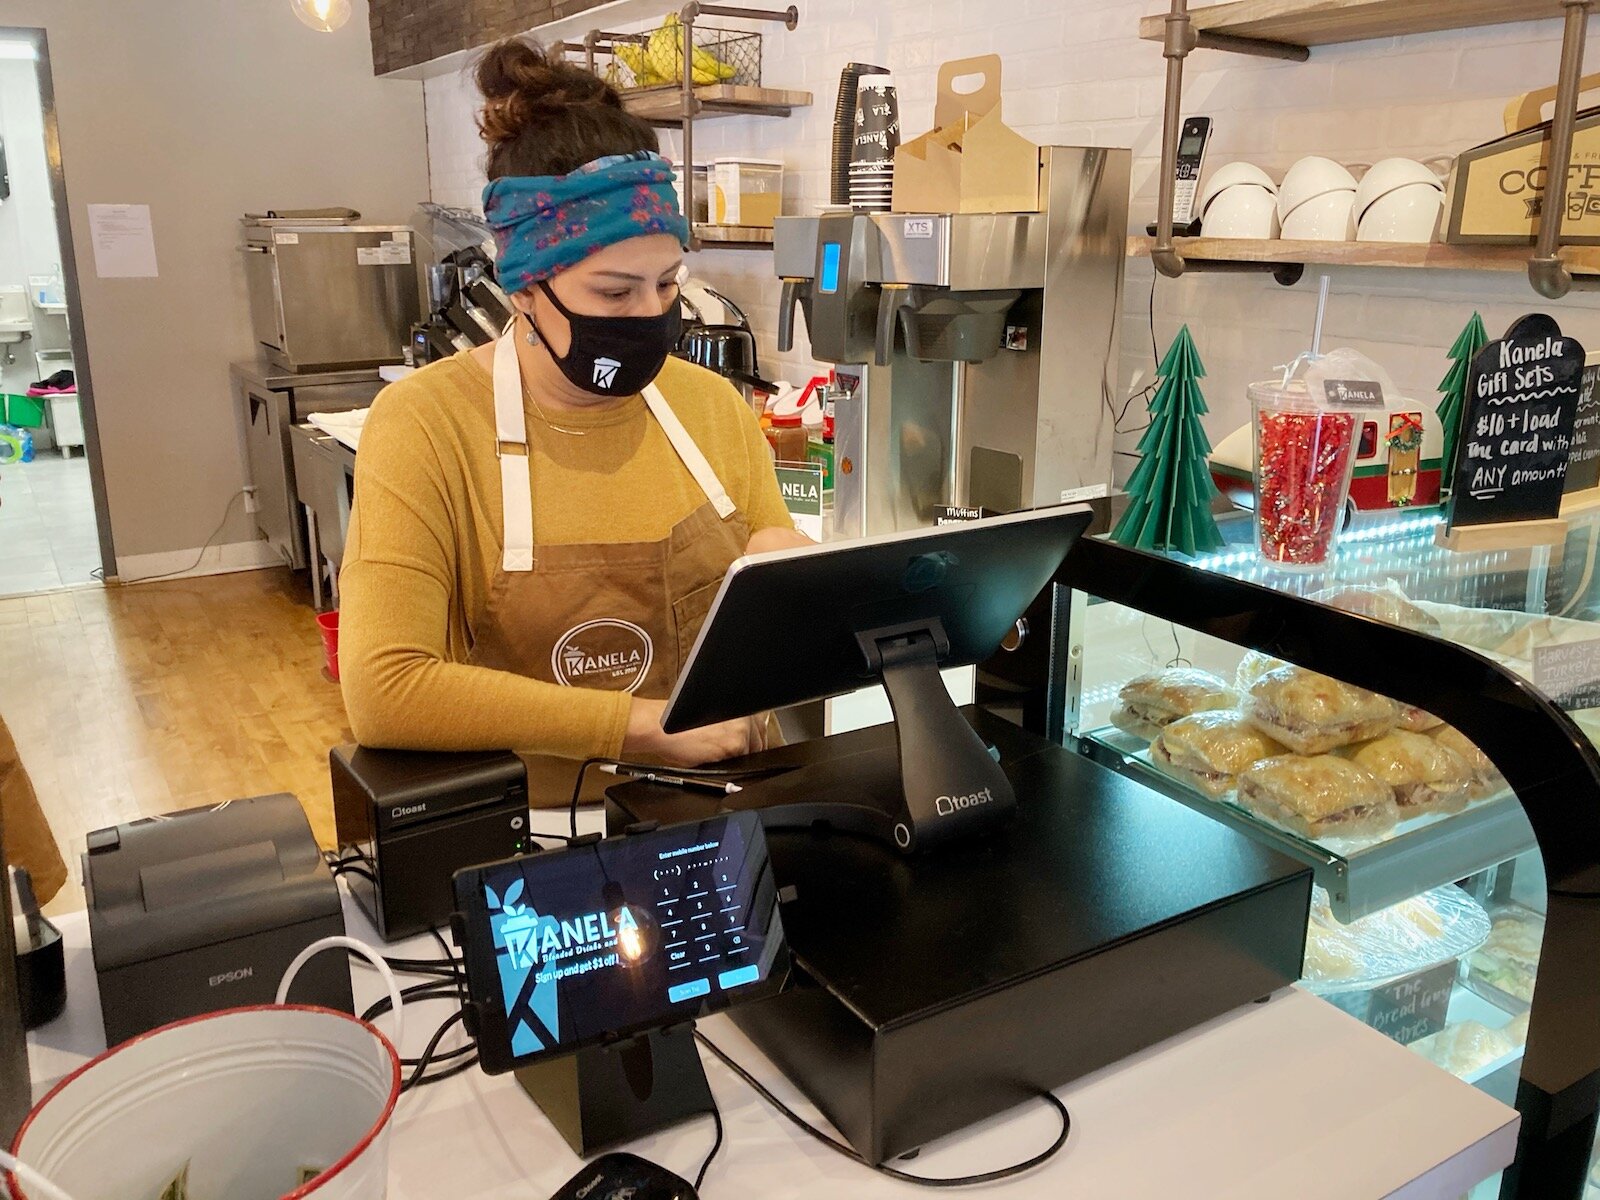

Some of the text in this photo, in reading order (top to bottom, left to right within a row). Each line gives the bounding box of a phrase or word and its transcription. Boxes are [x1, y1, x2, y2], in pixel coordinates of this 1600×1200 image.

[908, 222, 928, 232] XTS
[1500, 337, 1563, 368] Kanela
[1477, 365, 1554, 398] Gift Sets
[1338, 388, 1376, 401] KANELA
[1542, 434, 1568, 451] with
[1471, 464, 1507, 488] ANY
[564, 649, 641, 677] KANELA
[402, 802, 426, 815] toast
[952, 787, 994, 811] toast
[504, 906, 639, 969] KANELA
[542, 948, 574, 963] Blended
[209, 966, 253, 987] EPSON
[535, 971, 553, 984] Sign
[553, 969, 564, 980] up
[563, 963, 580, 976] and
